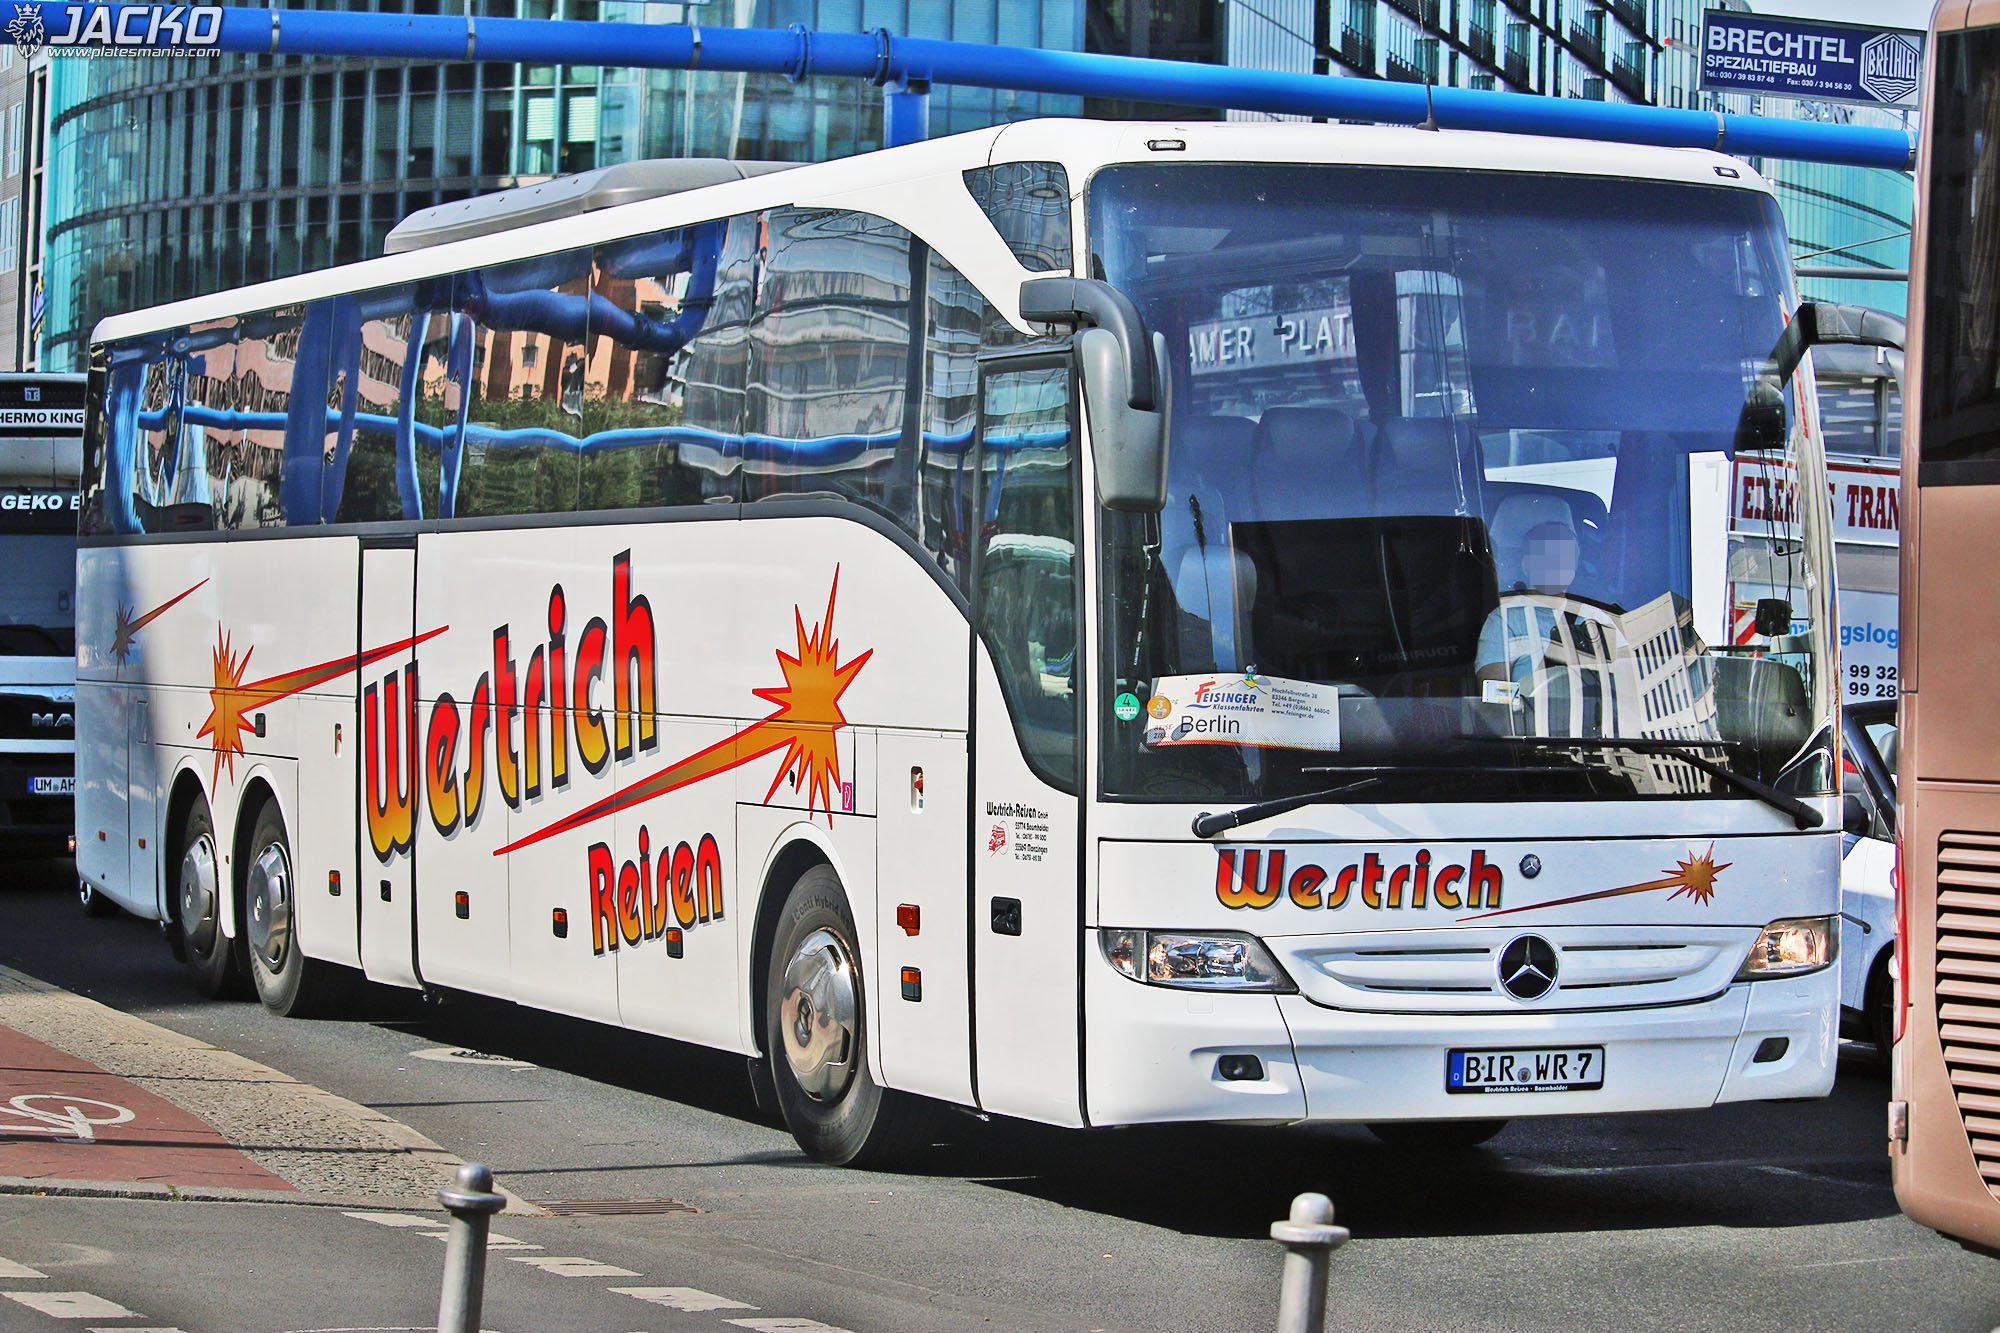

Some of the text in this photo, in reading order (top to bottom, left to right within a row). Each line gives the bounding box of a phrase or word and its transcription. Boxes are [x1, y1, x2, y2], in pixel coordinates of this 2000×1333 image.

[1707, 26, 1855, 64] BRECHTEL
[1705, 54, 1817, 77] SPEZIALTIEFBAU
[1867, 38, 1916, 79] BRECHTEL
[1720, 71, 1732, 79] 030
[1737, 73, 1746, 81] 39
[1747, 74, 1756, 82] 83
[1786, 78, 1800, 86] Fax:
[1801, 79, 1814, 87] 030
[1280, 313, 1356, 353] PLAT
[50, 412, 84, 424] KING
[1, 494, 63, 510] GEKO
[1847, 484, 1899, 531] TRAN
[1849, 664, 1897, 681] 99 32
[1123, 694, 1131, 707] 4
[1194, 681, 1257, 705] FEISINGER
[1849, 682, 1897, 698] 99 28
[364, 548, 661, 864] Westrich
[1212, 704, 1265, 713] Klassenfahrten
[1180, 715, 1240, 734] Berlin
[35, 778, 52, 791] UM
[986, 801, 1037, 819] Westrich-Reisen
[588, 824, 725, 957] Reisen
[1215, 848, 1503, 912] Westrich
[1465, 1053, 1593, 1083] BIR WR 7
